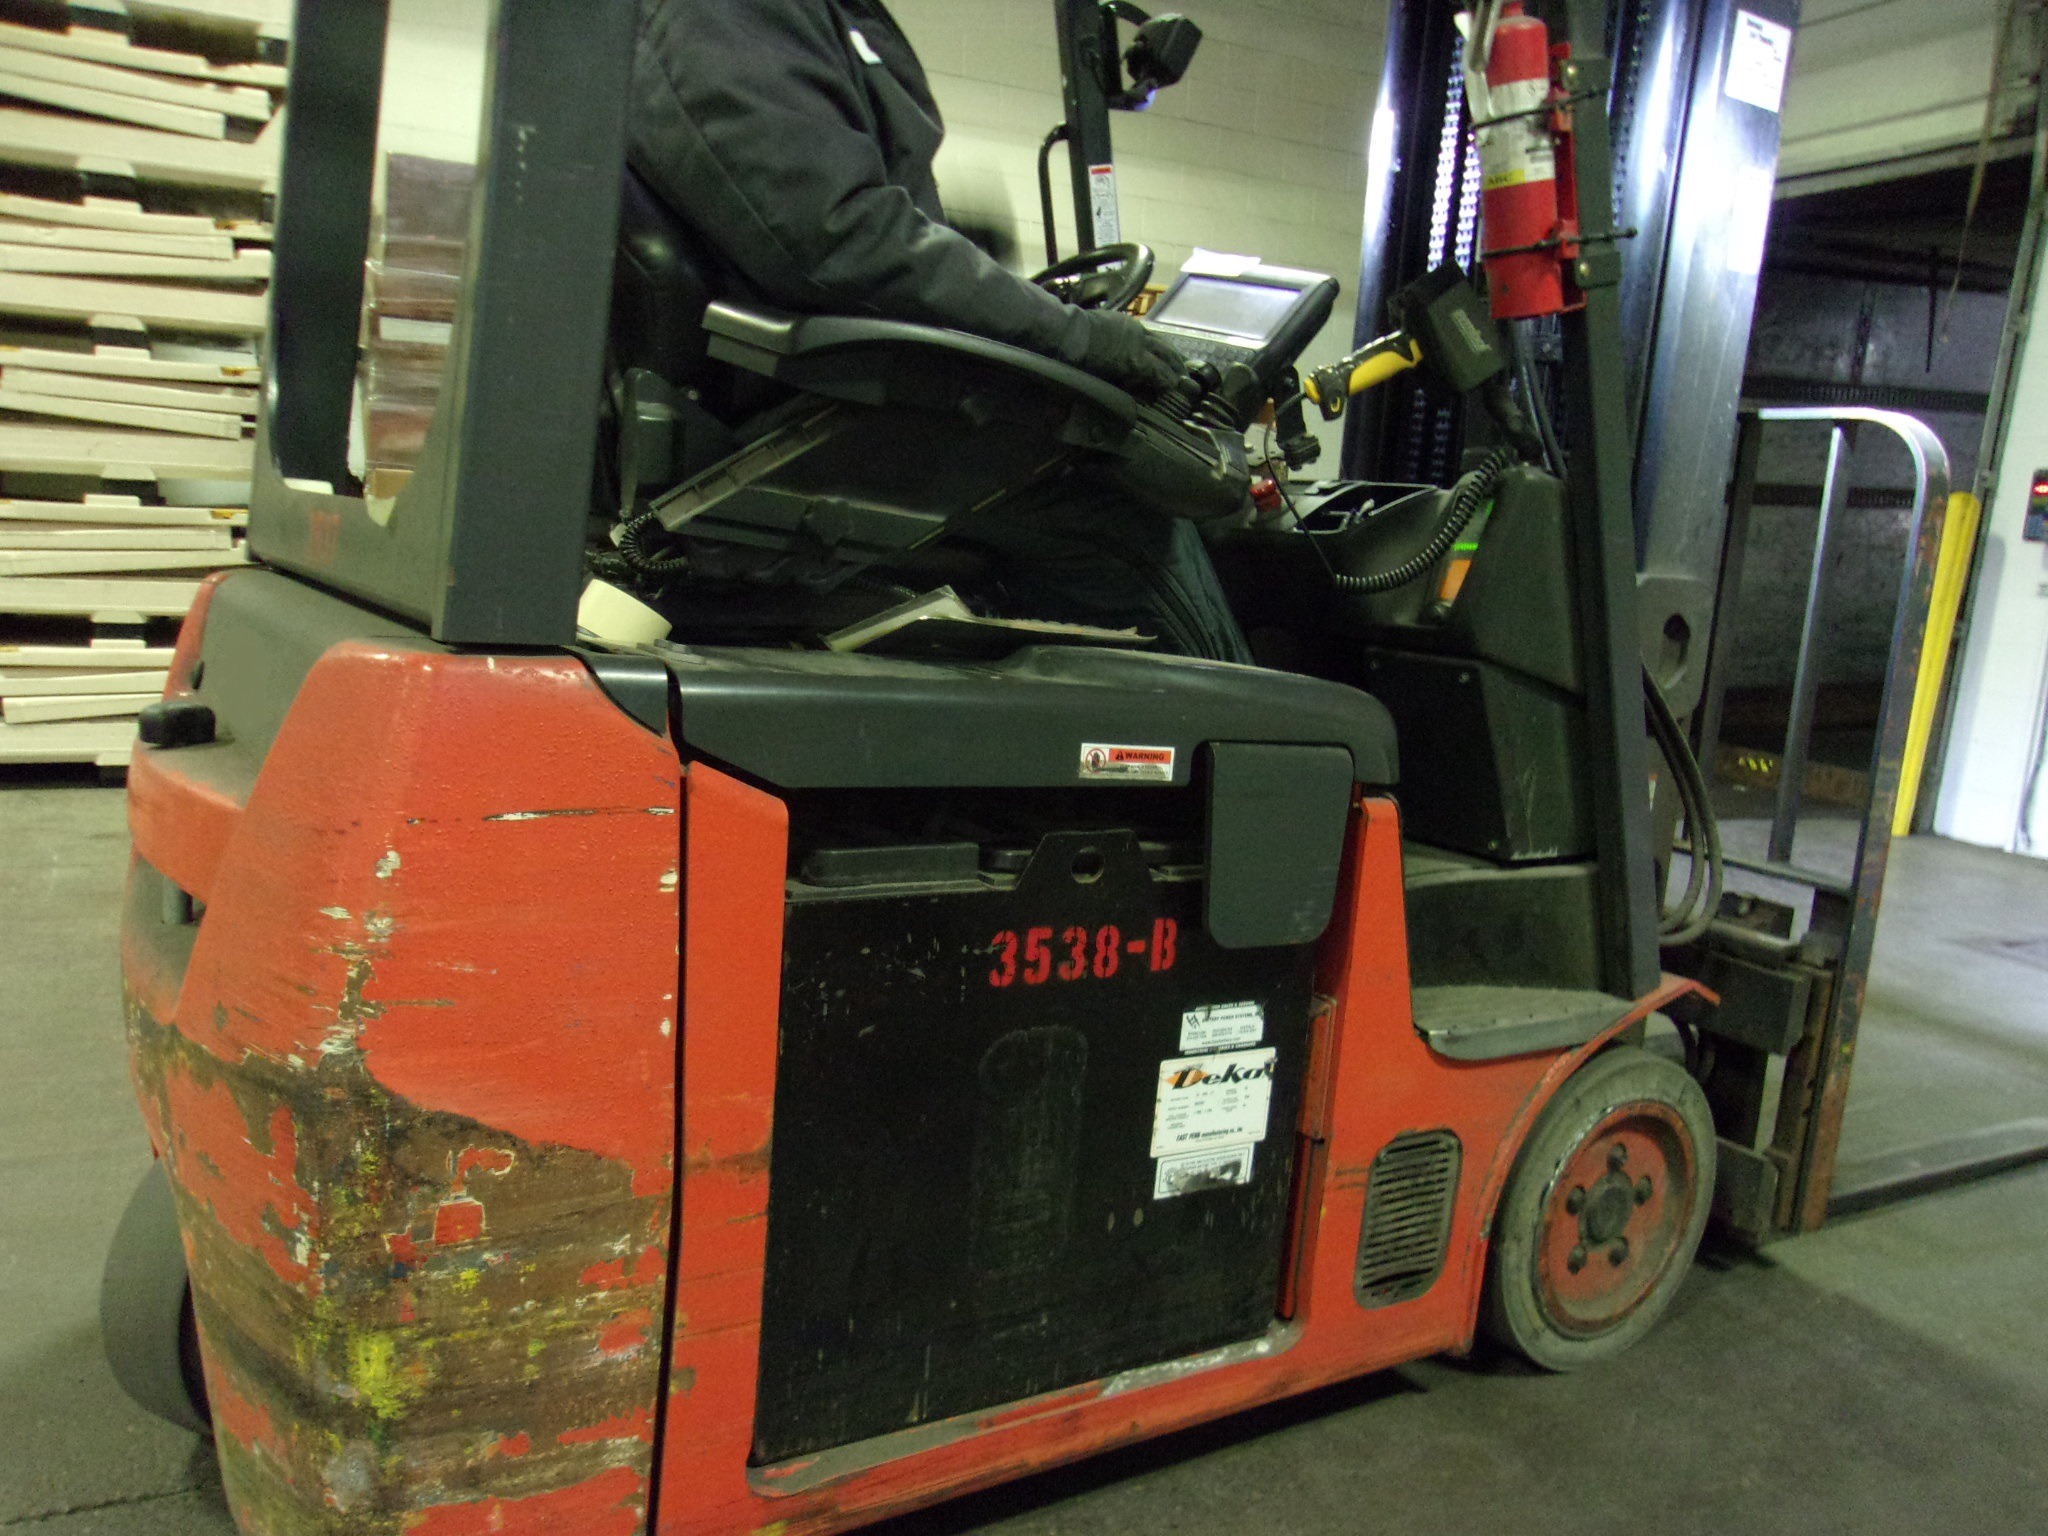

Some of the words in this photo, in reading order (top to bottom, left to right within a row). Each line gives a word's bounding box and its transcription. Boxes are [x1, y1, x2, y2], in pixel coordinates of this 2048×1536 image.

[1125, 752, 1165, 761] WARNING
[989, 917, 1178, 988] 3538-B
[1171, 1063, 1266, 1090] Deka
